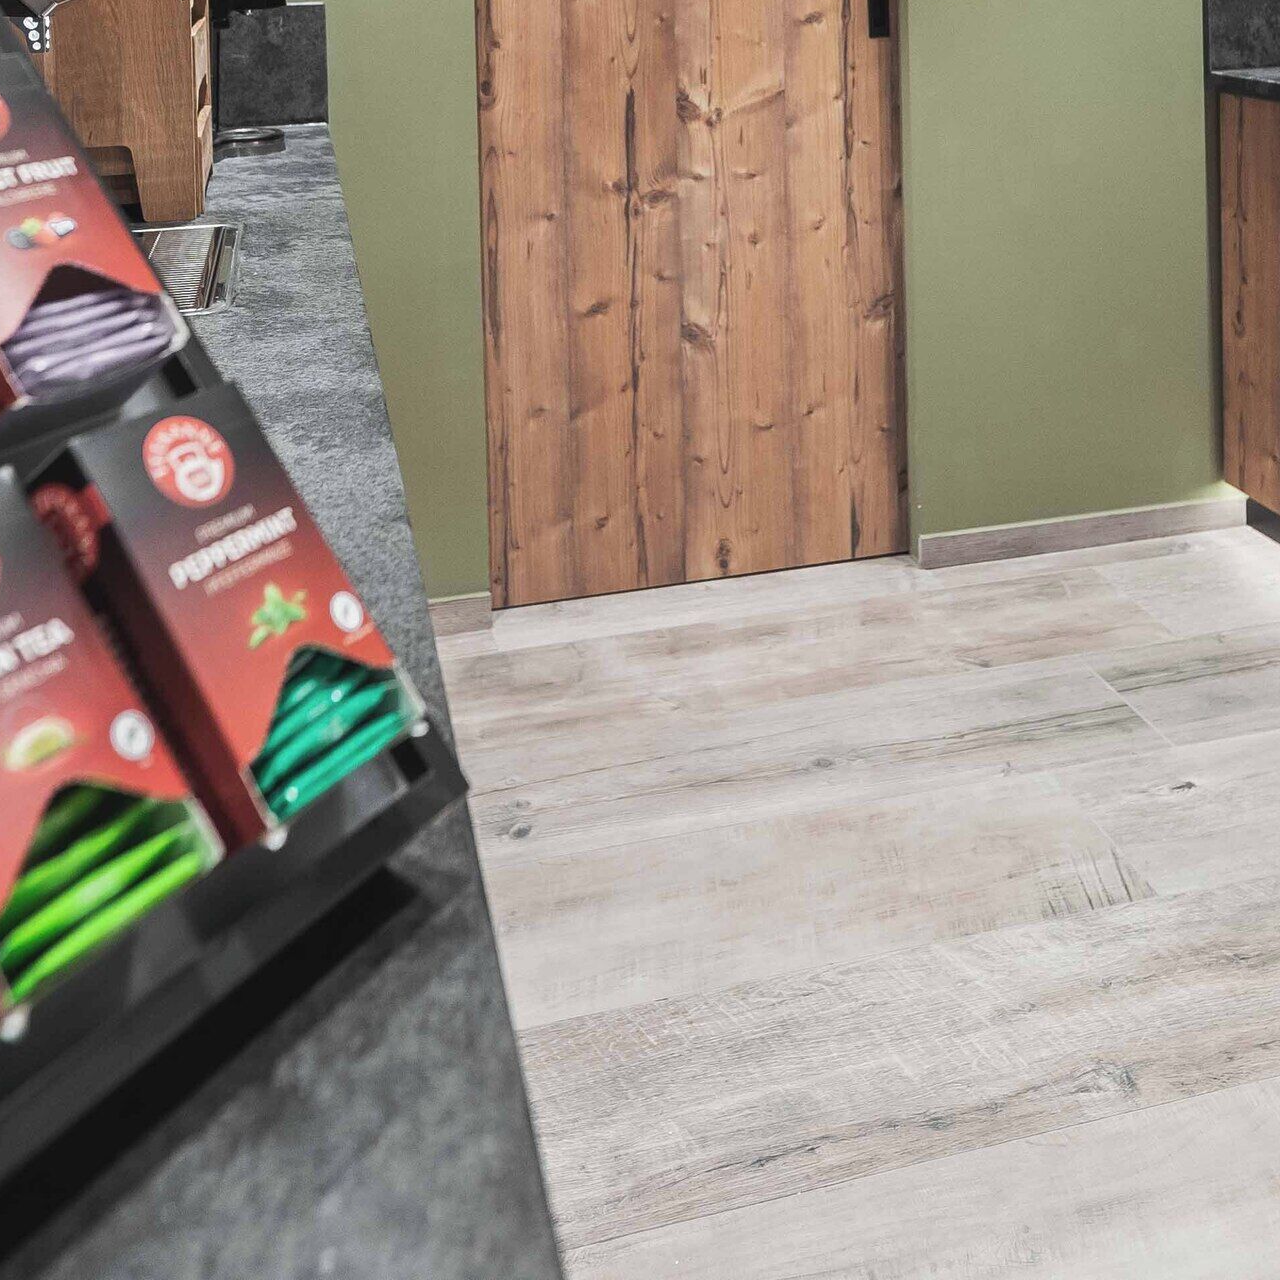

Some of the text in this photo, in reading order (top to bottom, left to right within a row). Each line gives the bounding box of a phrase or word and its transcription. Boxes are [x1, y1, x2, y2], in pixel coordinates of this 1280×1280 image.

[17, 156, 78, 184] FRUIT
[168, 506, 298, 590] PEPPERMINT
[12, 618, 75, 662] TEA
